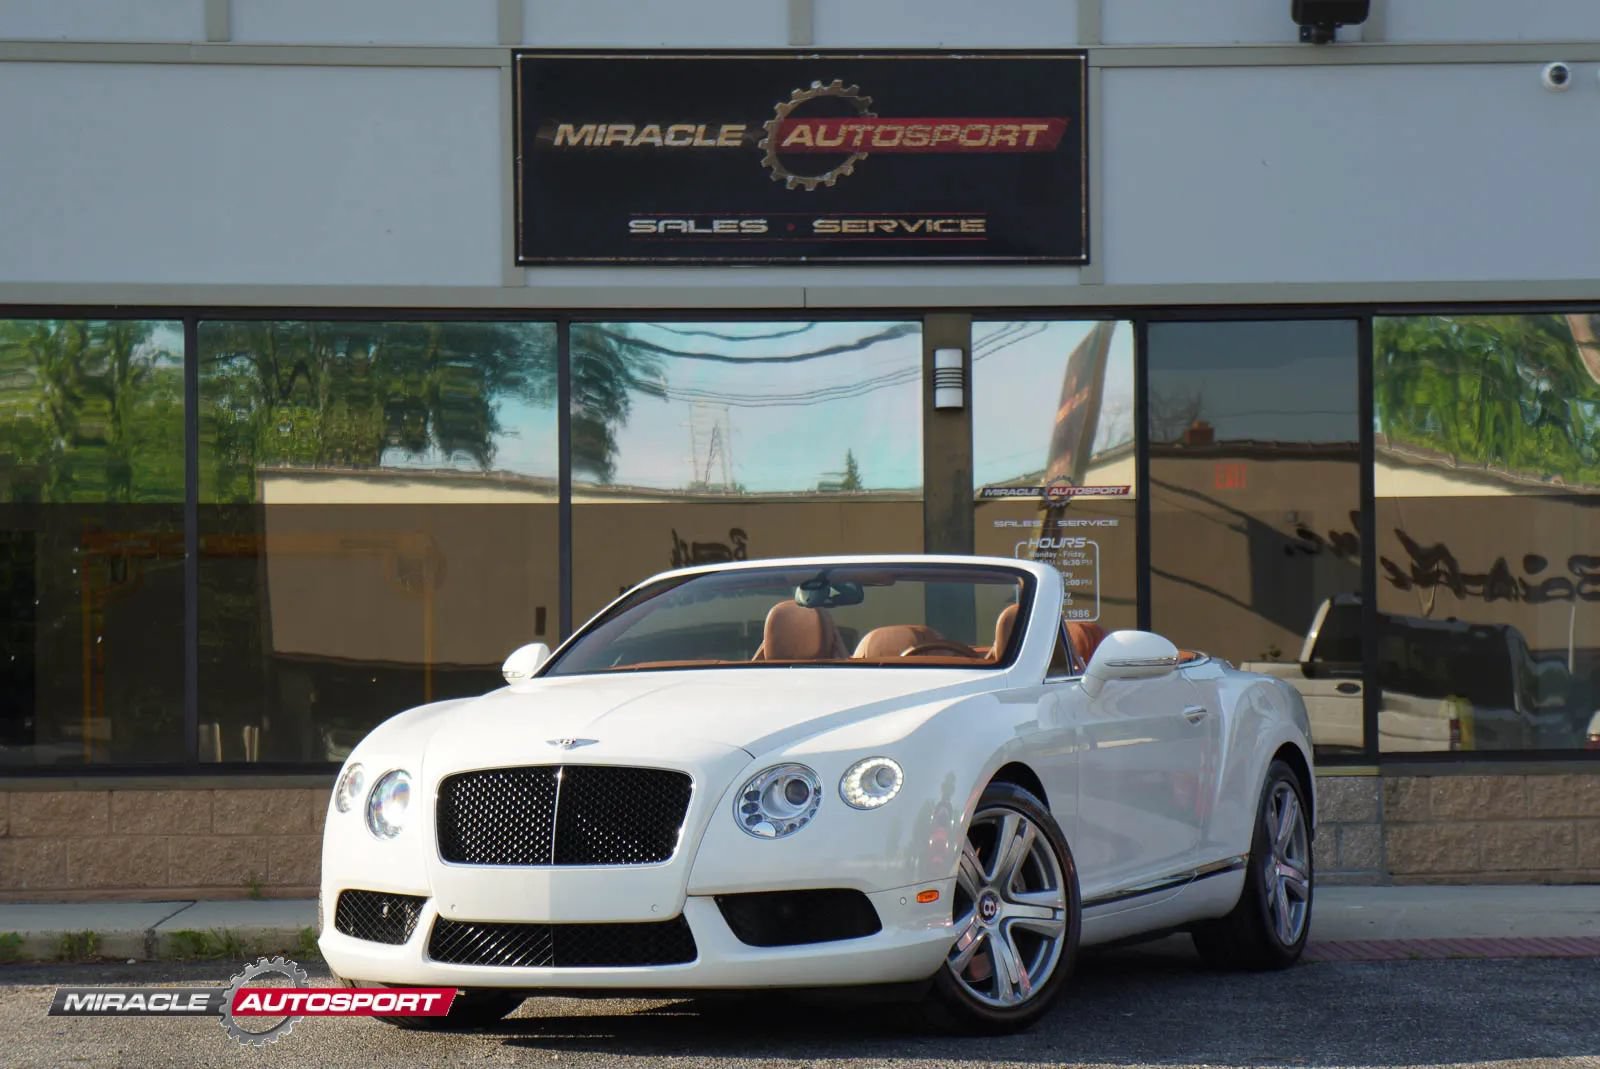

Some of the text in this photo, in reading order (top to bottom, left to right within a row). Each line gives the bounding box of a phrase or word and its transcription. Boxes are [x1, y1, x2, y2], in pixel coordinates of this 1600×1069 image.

[553, 123, 1050, 148] MIRACLE AUTOSPORT
[628, 218, 987, 235] SALES SERVICE
[984, 486, 1126, 496] MIRACLE AUTOSPORT
[1057, 519, 1119, 527] SERVICE
[1028, 537, 1087, 549] HOURS
